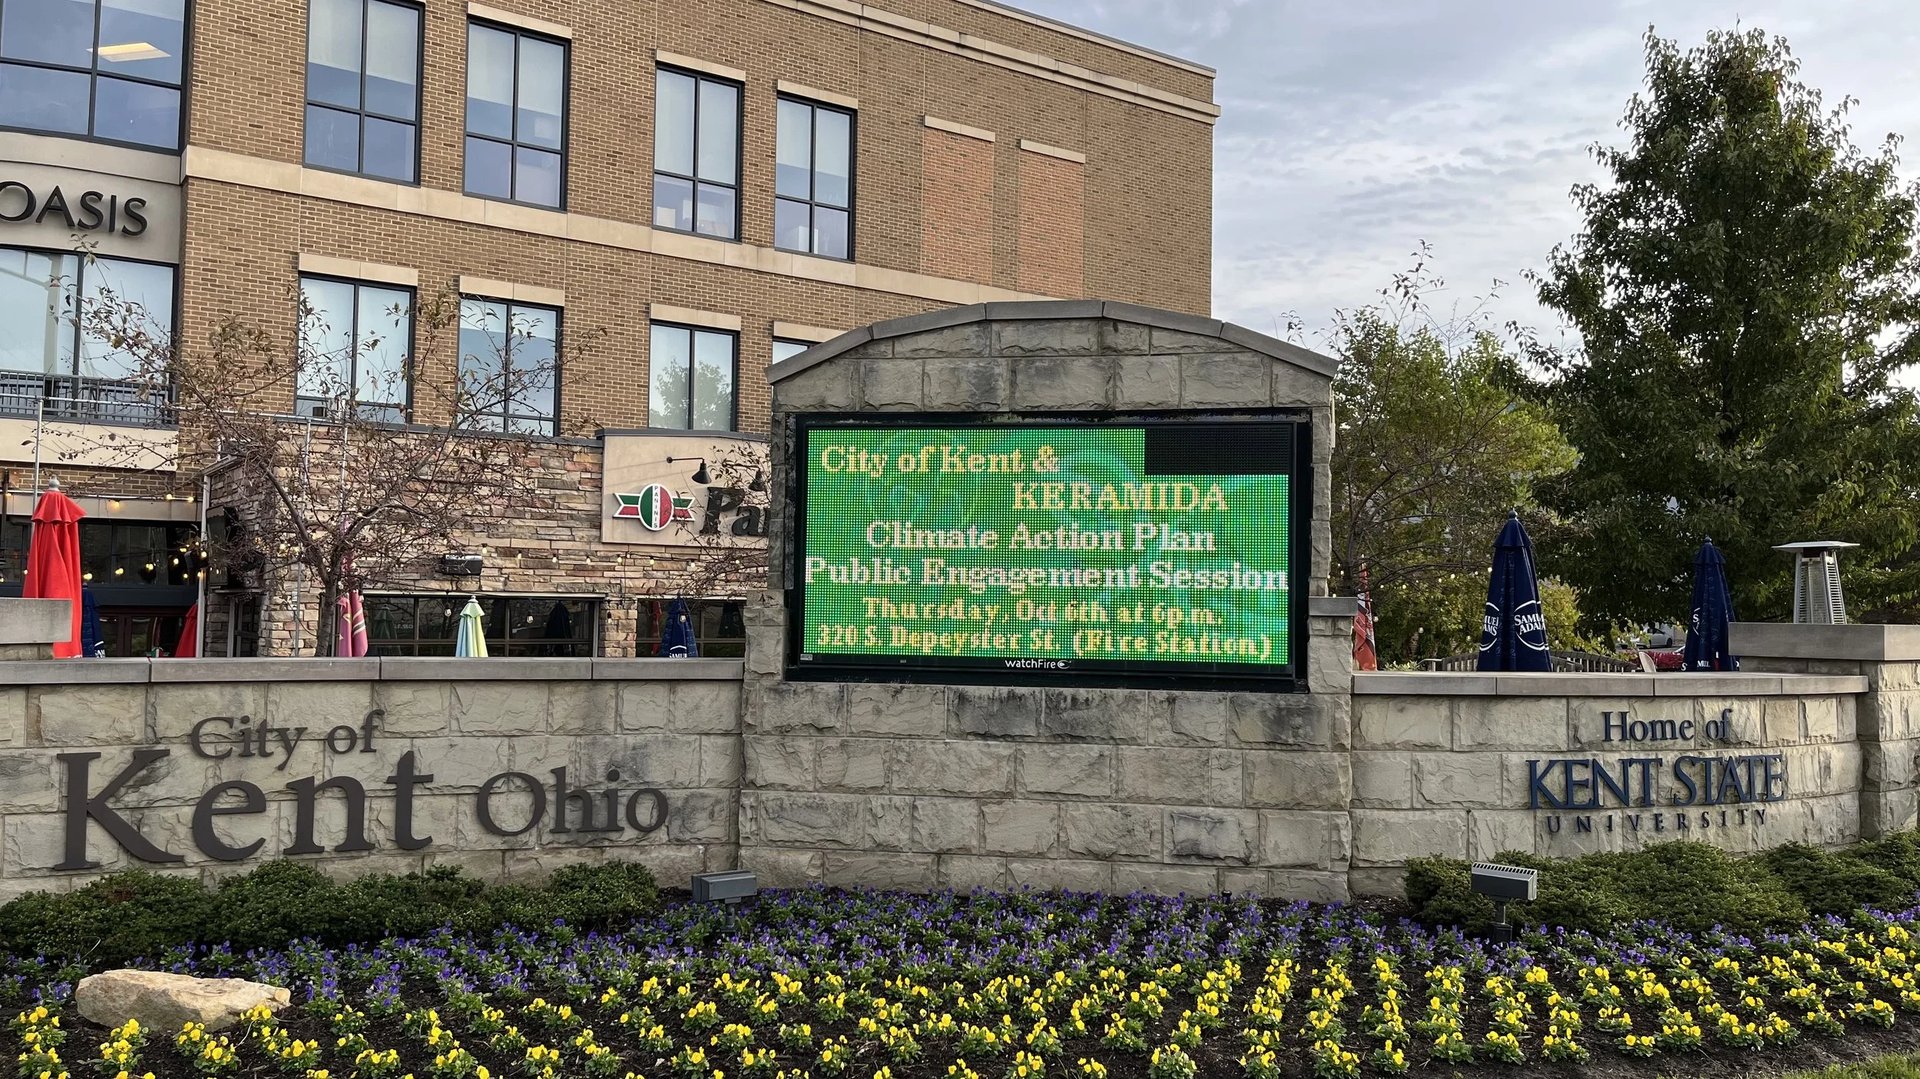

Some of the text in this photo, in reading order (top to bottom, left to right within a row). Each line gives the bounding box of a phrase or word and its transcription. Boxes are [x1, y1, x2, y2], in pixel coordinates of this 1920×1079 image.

[0, 181, 148, 236] OASIS
[821, 445, 1061, 477] City of Kent &
[1013, 482, 1229, 511] KERAMIDA
[866, 521, 1216, 551] Climate Action Plan
[805, 556, 1288, 594] Public Engagement Session
[863, 597, 1009, 625] Thursday,
[1015, 599, 1057, 622] Oct
[1064, 600, 1109, 623] 6th
[1117, 602, 1144, 623] at
[817, 624, 1272, 660] 320 S. Depeyster St. (Fire Station)
[1004, 658, 1056, 669] watchFire
[190, 709, 385, 769] City of
[1602, 708, 1733, 742] Home of
[1525, 754, 1786, 810] KENT STATE
[55, 748, 670, 871] Kent Ohio
[1547, 809, 1767, 834] UNIVERSITY
